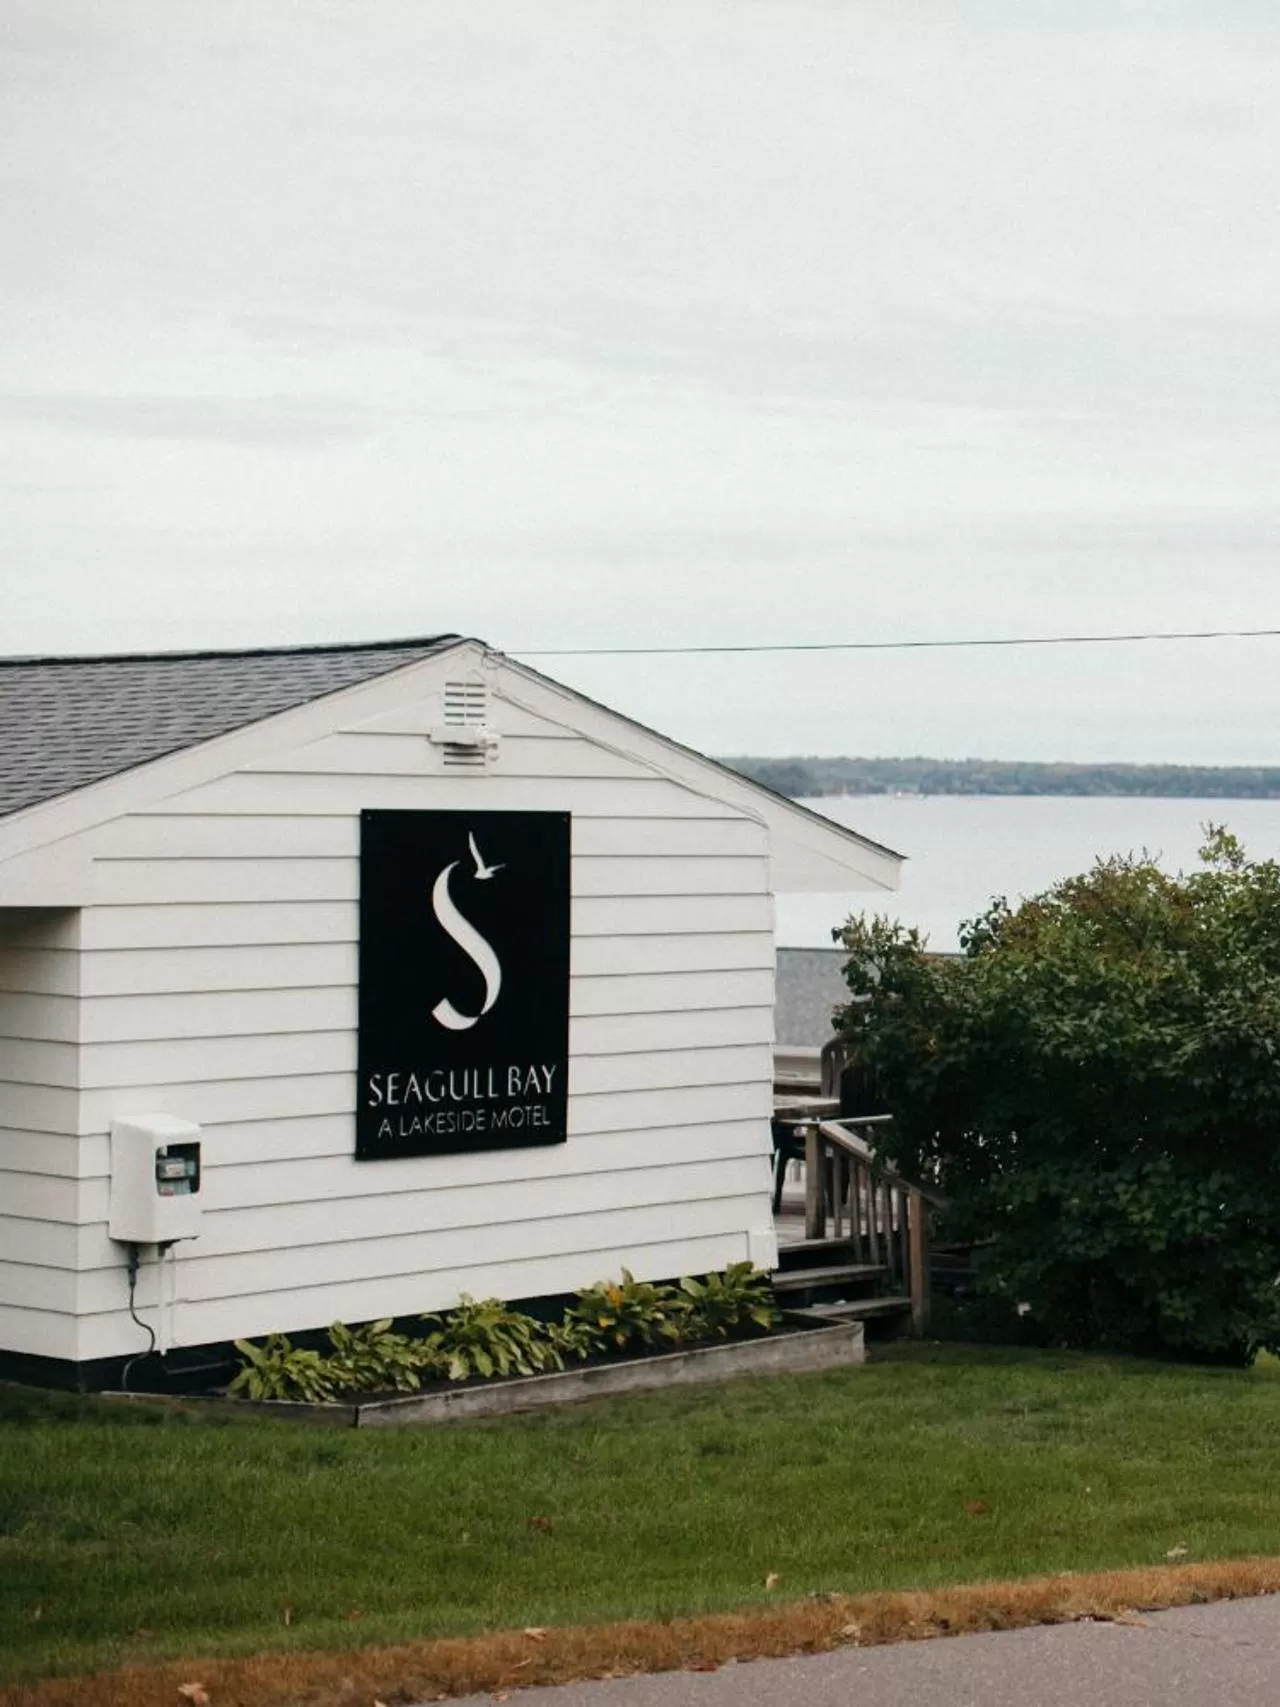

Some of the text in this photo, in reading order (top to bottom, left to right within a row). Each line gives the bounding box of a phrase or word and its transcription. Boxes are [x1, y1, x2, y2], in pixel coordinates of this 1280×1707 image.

[368, 1064, 557, 1107] SEAGULL BAY
[378, 1104, 551, 1138] A LAKESIDE MOTEL
